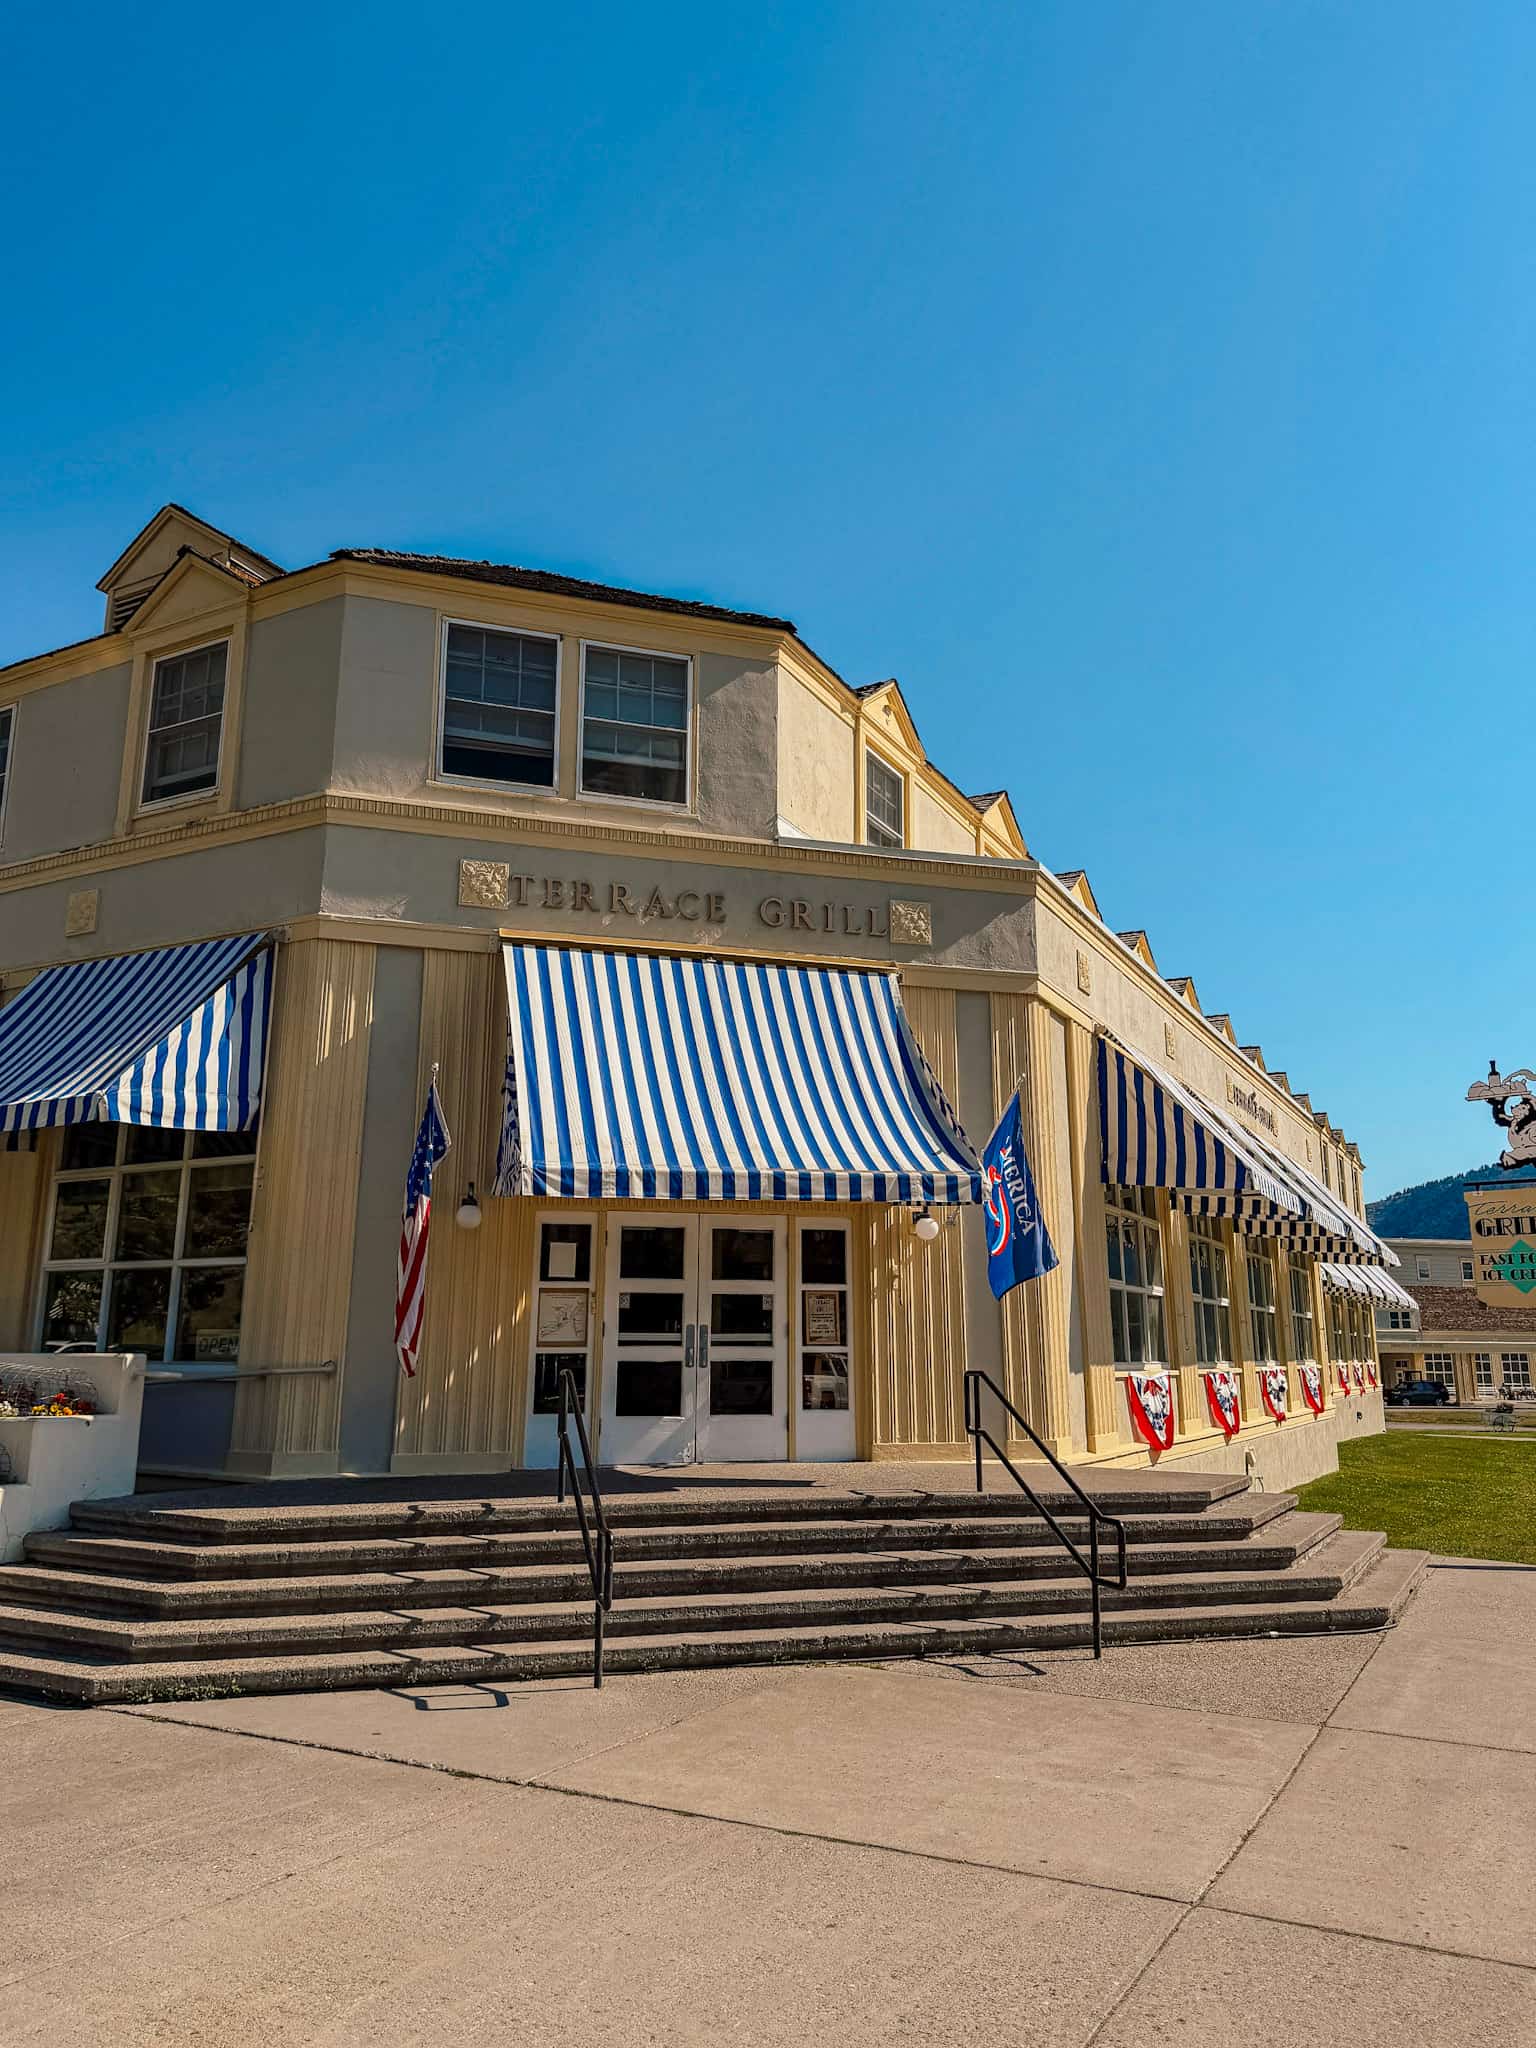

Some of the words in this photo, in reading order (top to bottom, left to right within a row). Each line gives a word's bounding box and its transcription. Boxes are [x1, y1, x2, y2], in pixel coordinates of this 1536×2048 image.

[511, 874, 727, 923] TERRACE
[759, 897, 888, 937] GRILL
[1480, 1253, 1514, 1265] FAST
[1481, 1270, 1506, 1281] ICE
[199, 1336, 240, 1353] OPEN
